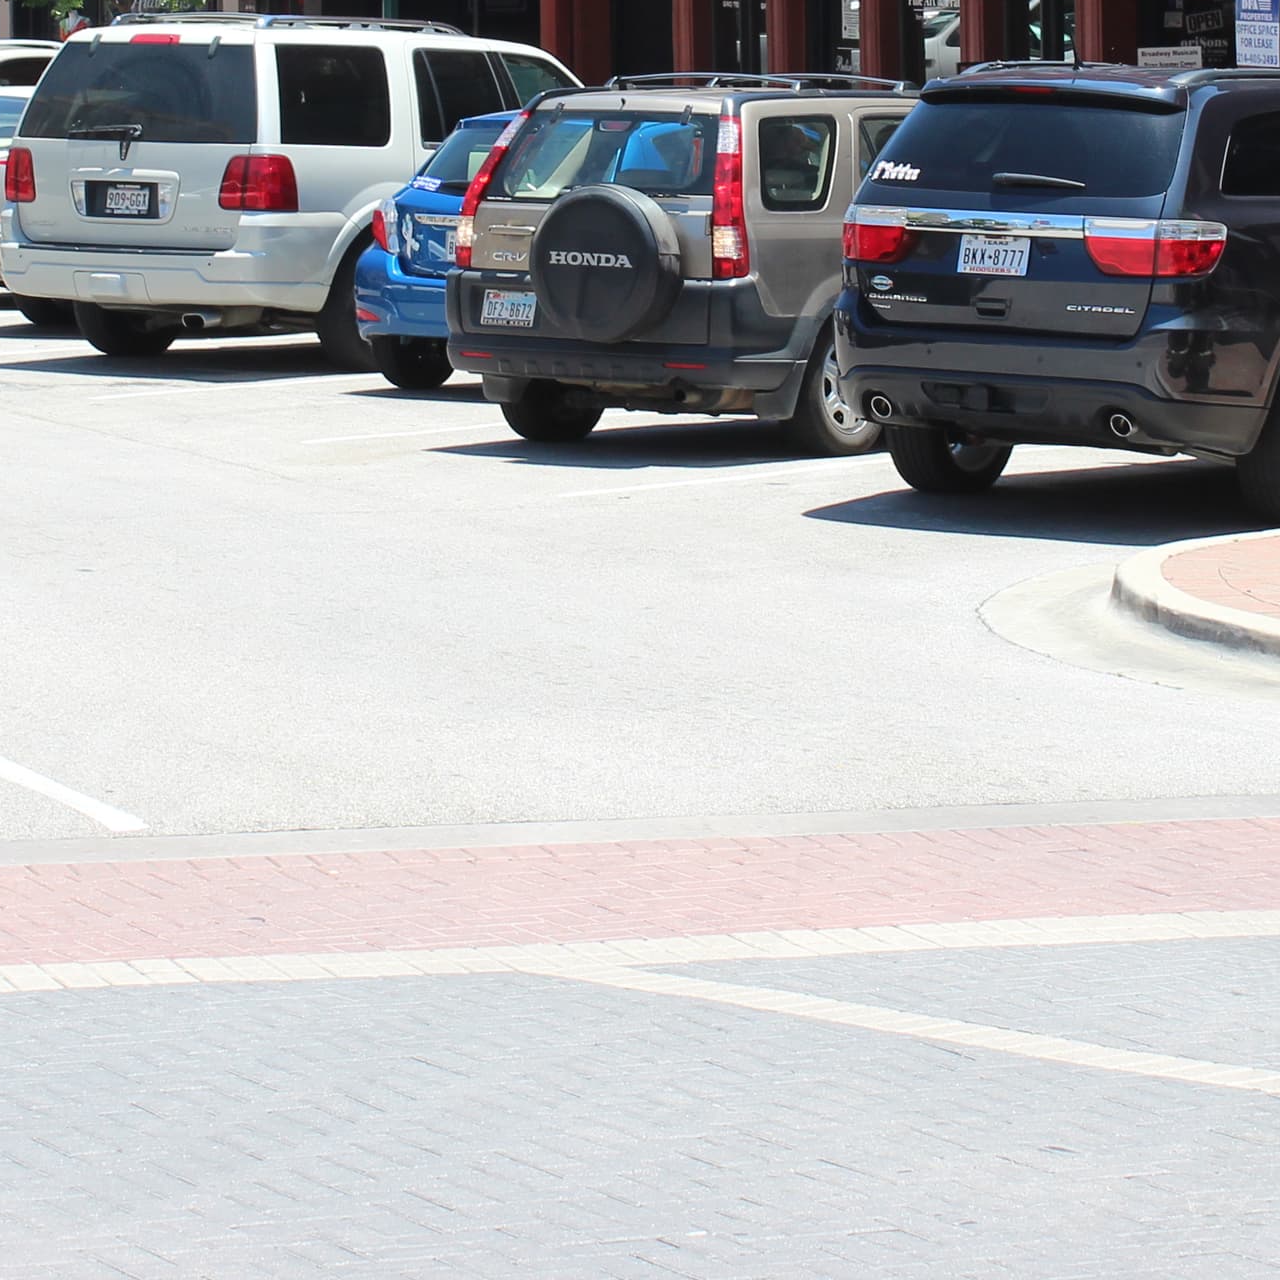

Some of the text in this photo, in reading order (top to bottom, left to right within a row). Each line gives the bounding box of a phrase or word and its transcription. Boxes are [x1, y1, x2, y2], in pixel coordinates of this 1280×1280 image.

[1242, 0, 1259, 10] DFA
[1237, 25, 1278, 36] OFFICE SPACE
[1241, 38, 1273, 49] FOR LEASE
[492, 251, 527, 261] CR-V
[548, 250, 632, 269] HONDA
[1066, 304, 1136, 314] CITADEL
